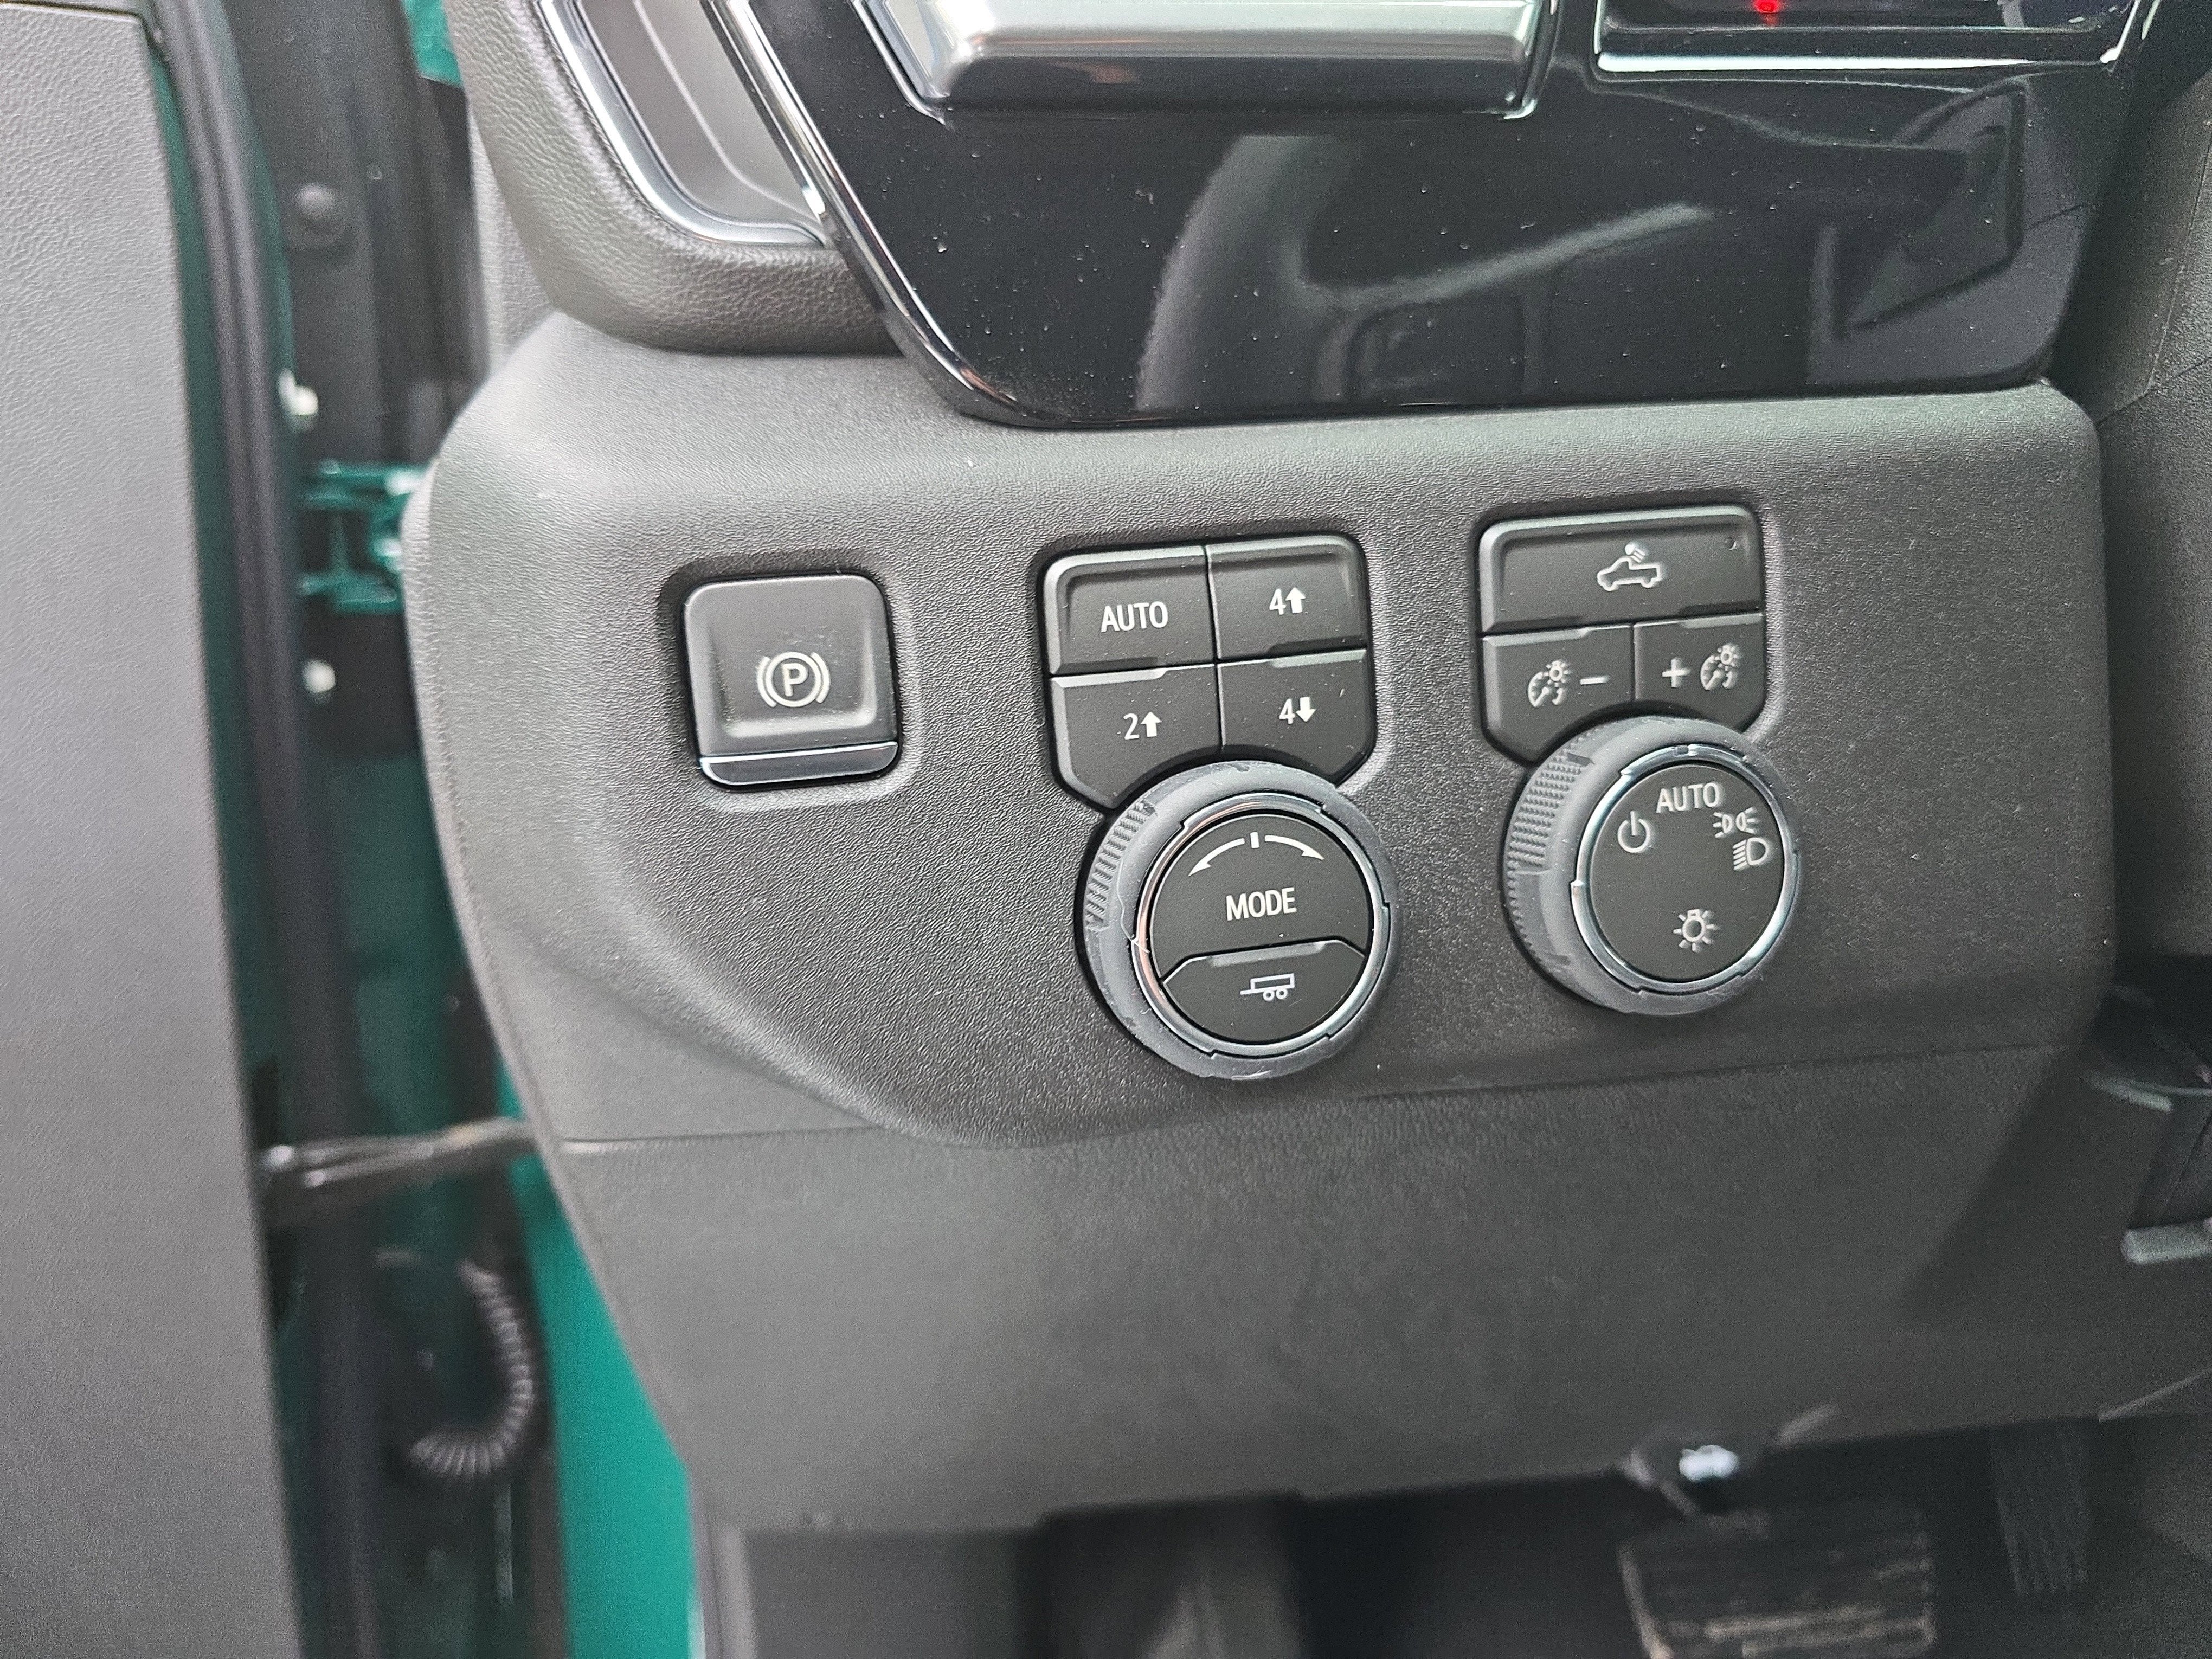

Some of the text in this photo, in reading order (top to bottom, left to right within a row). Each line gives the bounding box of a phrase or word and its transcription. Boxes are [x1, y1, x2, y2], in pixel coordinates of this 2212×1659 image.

[1101, 601, 1168, 633] AUTO
[1269, 589, 1286, 616] 4
[782, 662, 809, 697] P
[1123, 713, 1140, 740] 2
[1279, 698, 1295, 725] 4
[1656, 782, 1723, 814] AUTO
[1225, 887, 1297, 921] MODE
